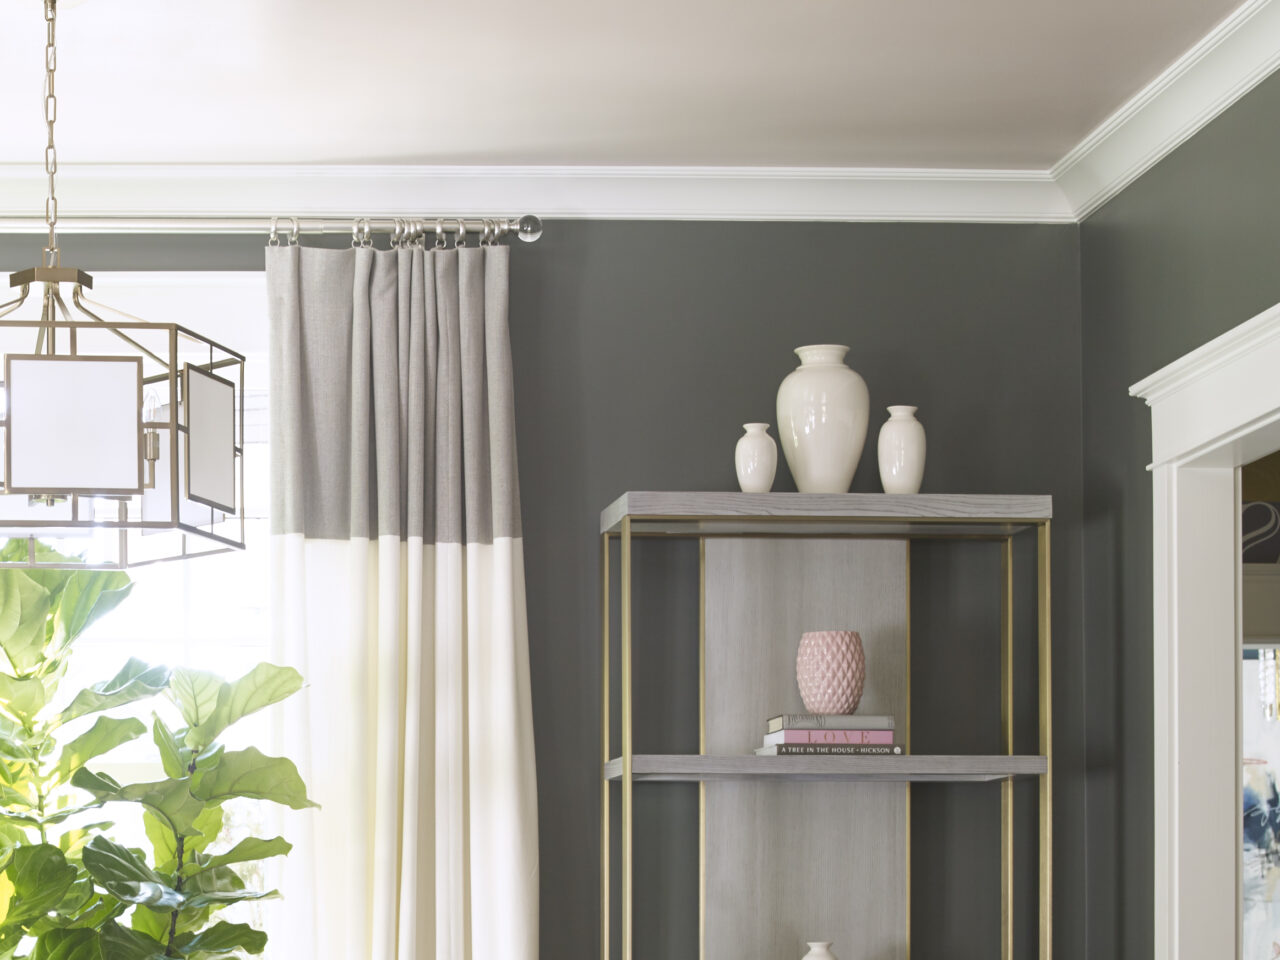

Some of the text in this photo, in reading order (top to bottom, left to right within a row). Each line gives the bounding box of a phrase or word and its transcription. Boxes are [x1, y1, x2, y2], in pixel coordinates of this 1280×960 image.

[807, 731, 870, 744] LOVE
[781, 746, 891, 754] A TREE IN THE HOUSE HICKSON
